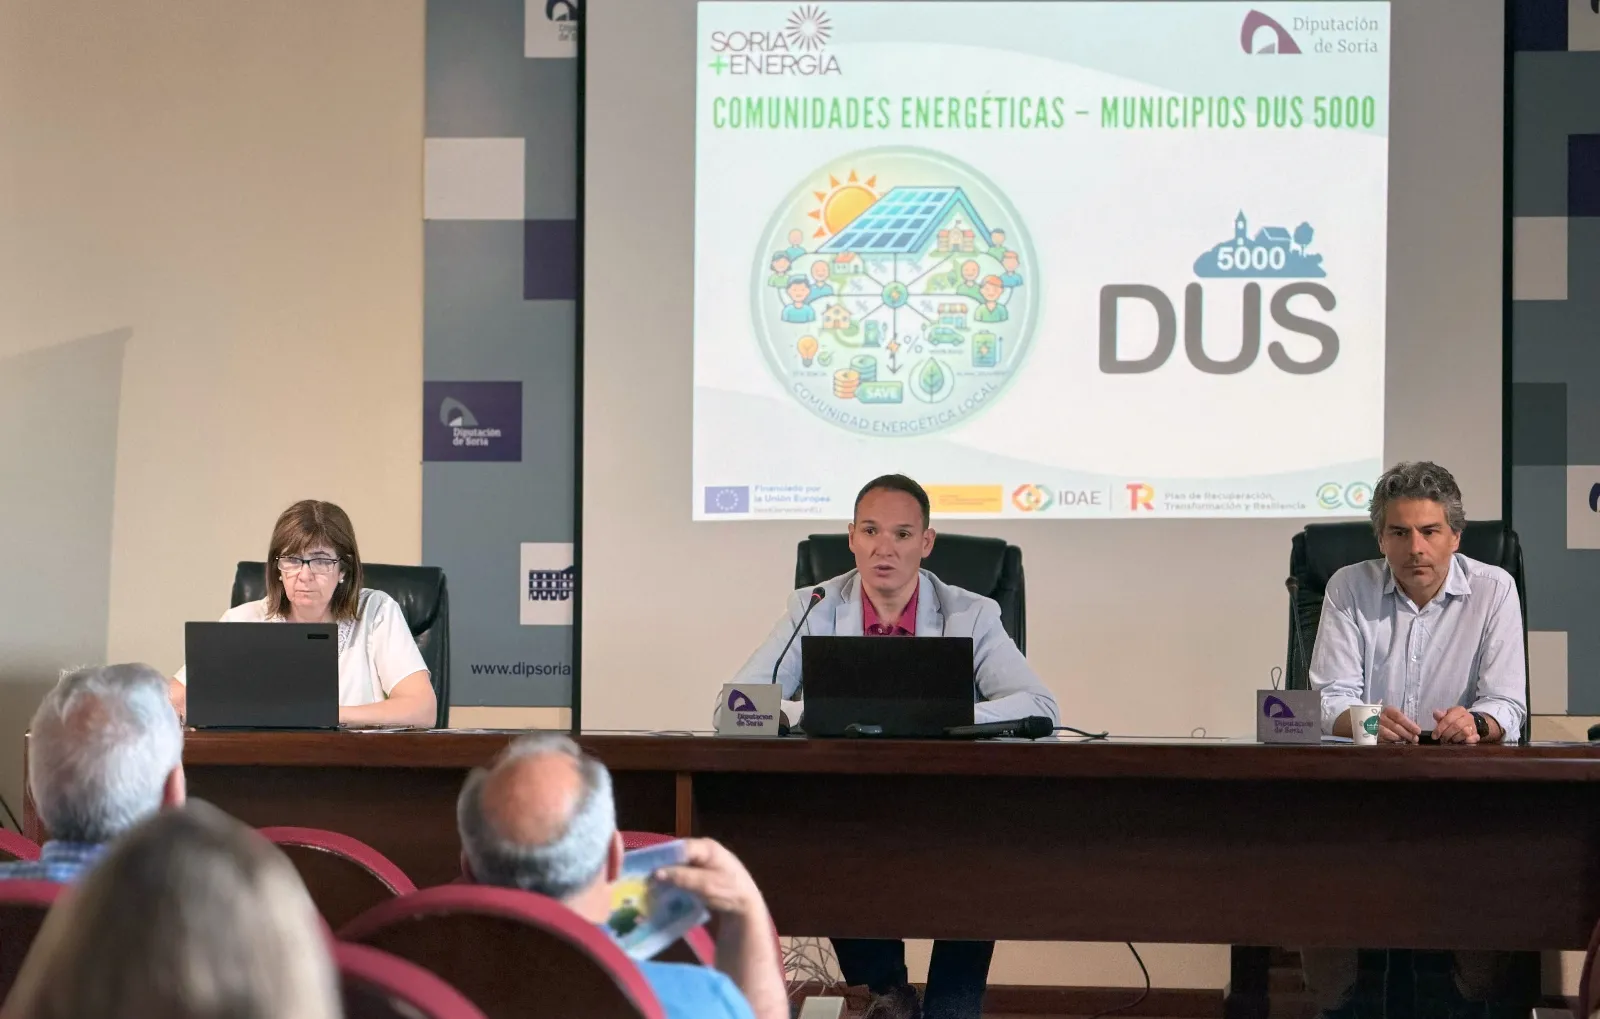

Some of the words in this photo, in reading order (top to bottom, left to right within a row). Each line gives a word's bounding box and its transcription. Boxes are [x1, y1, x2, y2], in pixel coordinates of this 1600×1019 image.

[1293, 17, 1379, 35] Diputación
[711, 31, 789, 52] SORIA
[1314, 39, 1333, 53] de
[1337, 38, 1378, 53] Soria
[713, 96, 890, 129] COMUNIDADES
[902, 90, 1065, 129] ENERGÉTICAS
[1101, 96, 1246, 128] MUNICIPIOS
[1256, 96, 1304, 128] DUS
[1313, 96, 1376, 128] 5000
[1217, 246, 1286, 271] 5000
[1099, 281, 1340, 376] DUS
[866, 386, 899, 401] SAVE
[793, 382, 870, 430] COMUNIDAD
[957, 381, 998, 415] LOCAL
[452, 427, 502, 437] Diputación
[452, 437, 464, 446] de
[465, 437, 489, 446] Soria
[1059, 490, 1102, 506] IDAE
